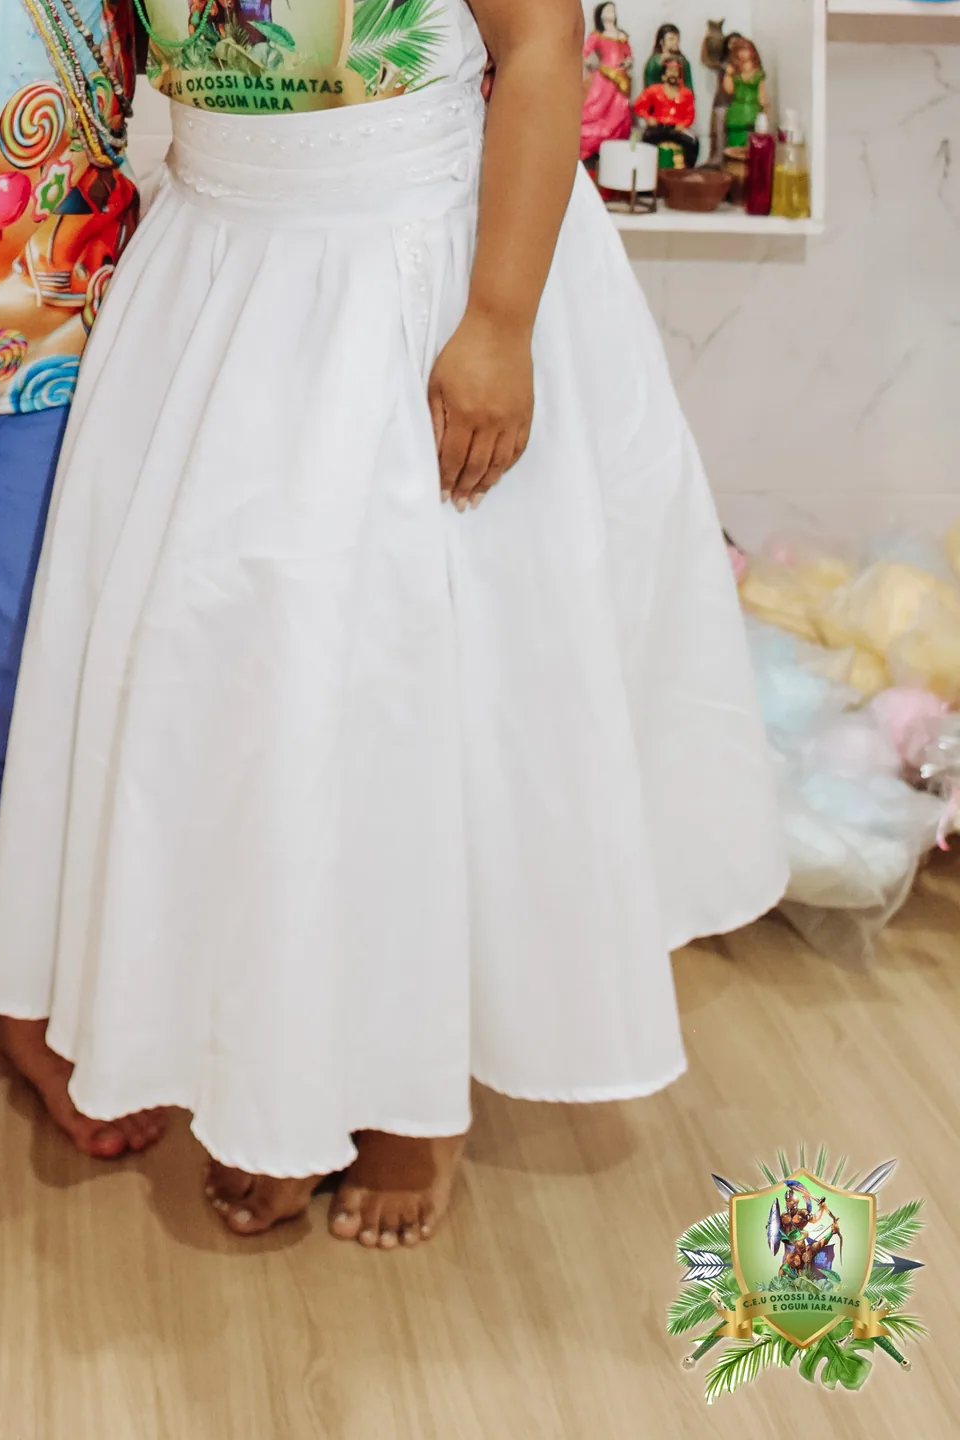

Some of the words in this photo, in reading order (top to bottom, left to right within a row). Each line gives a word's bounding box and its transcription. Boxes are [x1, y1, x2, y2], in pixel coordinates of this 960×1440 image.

[186, 75, 239, 92] OXOSSI
[243, 75, 275, 91] DAS
[281, 78, 344, 94] MATAS
[204, 95, 250, 109] OGUM
[254, 96, 294, 111] IARA
